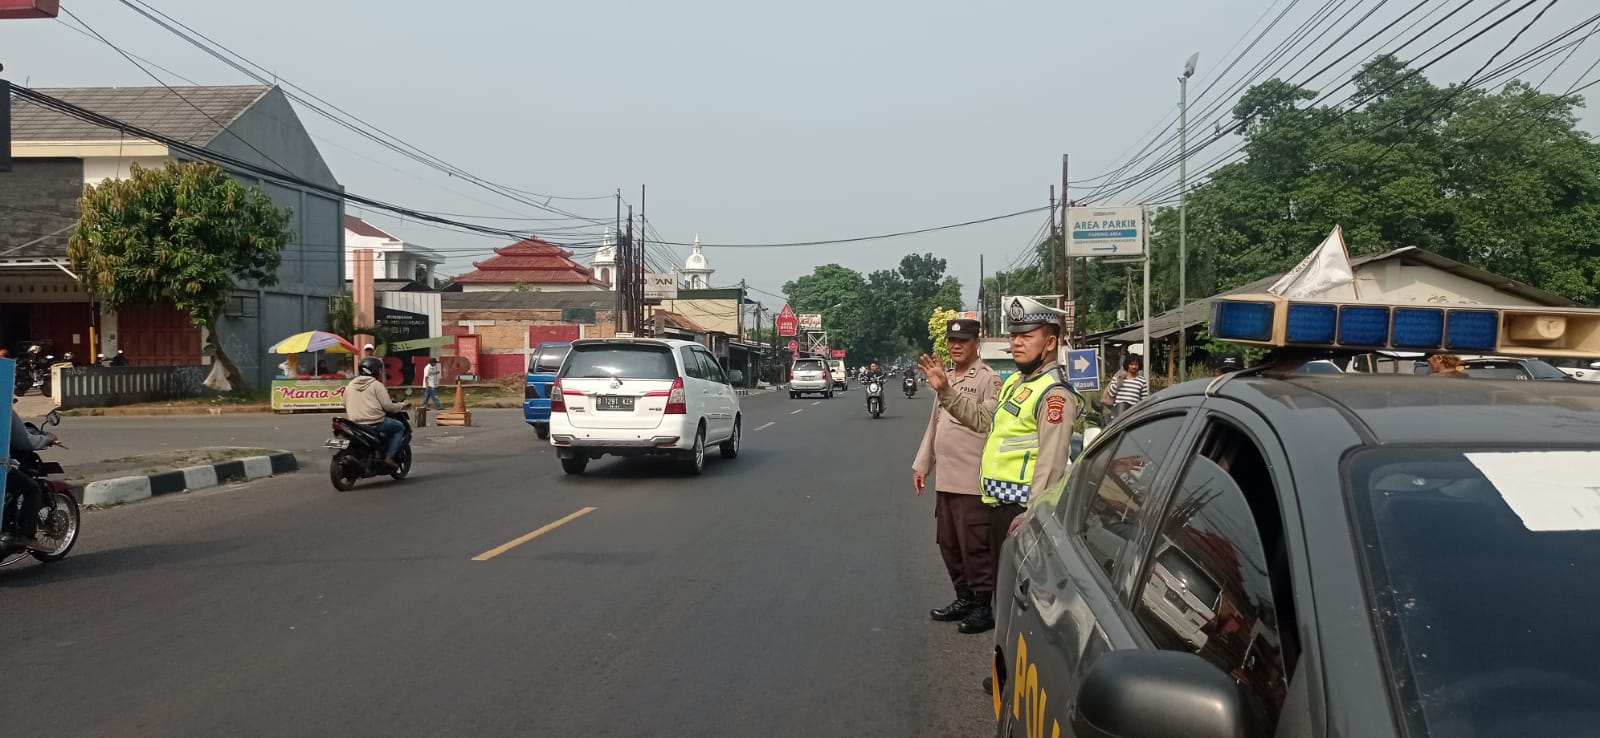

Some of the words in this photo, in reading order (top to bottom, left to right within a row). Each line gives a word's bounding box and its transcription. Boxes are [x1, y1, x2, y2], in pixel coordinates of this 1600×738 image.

[1074, 221, 1100, 229] AREA
[1102, 220, 1136, 228] PARKIR
[281, 387, 329, 399] Mama
